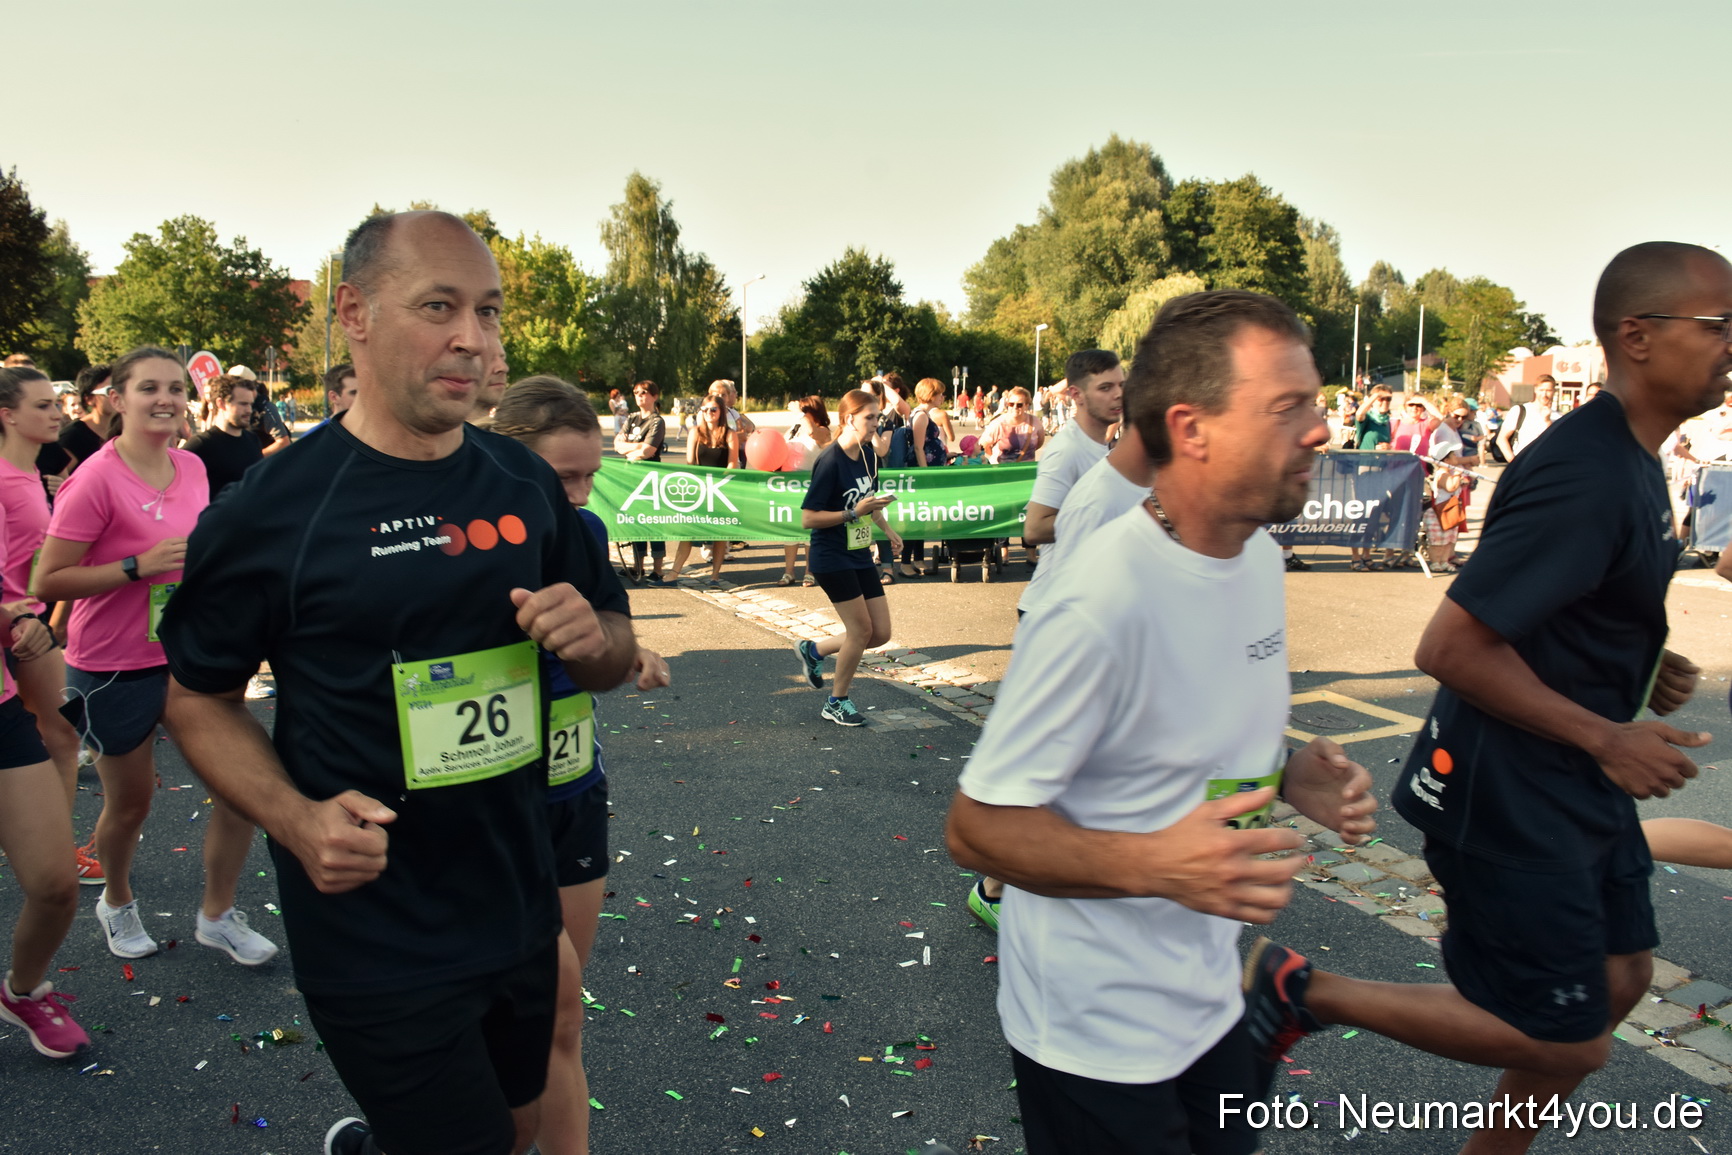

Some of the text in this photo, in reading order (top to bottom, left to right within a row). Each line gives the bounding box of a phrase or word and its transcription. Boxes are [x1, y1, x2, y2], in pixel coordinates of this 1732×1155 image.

[619, 470, 740, 513] AOK
[768, 500, 793, 523] in
[897, 499, 995, 522] Händen
[1296, 493, 1380, 520] cher
[380, 515, 436, 534] APTIV
[616, 512, 742, 525] Die Gesundheitskasse.
[1266, 522, 1368, 534] AUTOMOBILE
[370, 535, 452, 557] Running Team
[455, 693, 510, 747] 26
[440, 742, 492, 763] Schmoll
[553, 724, 580, 761] 21
